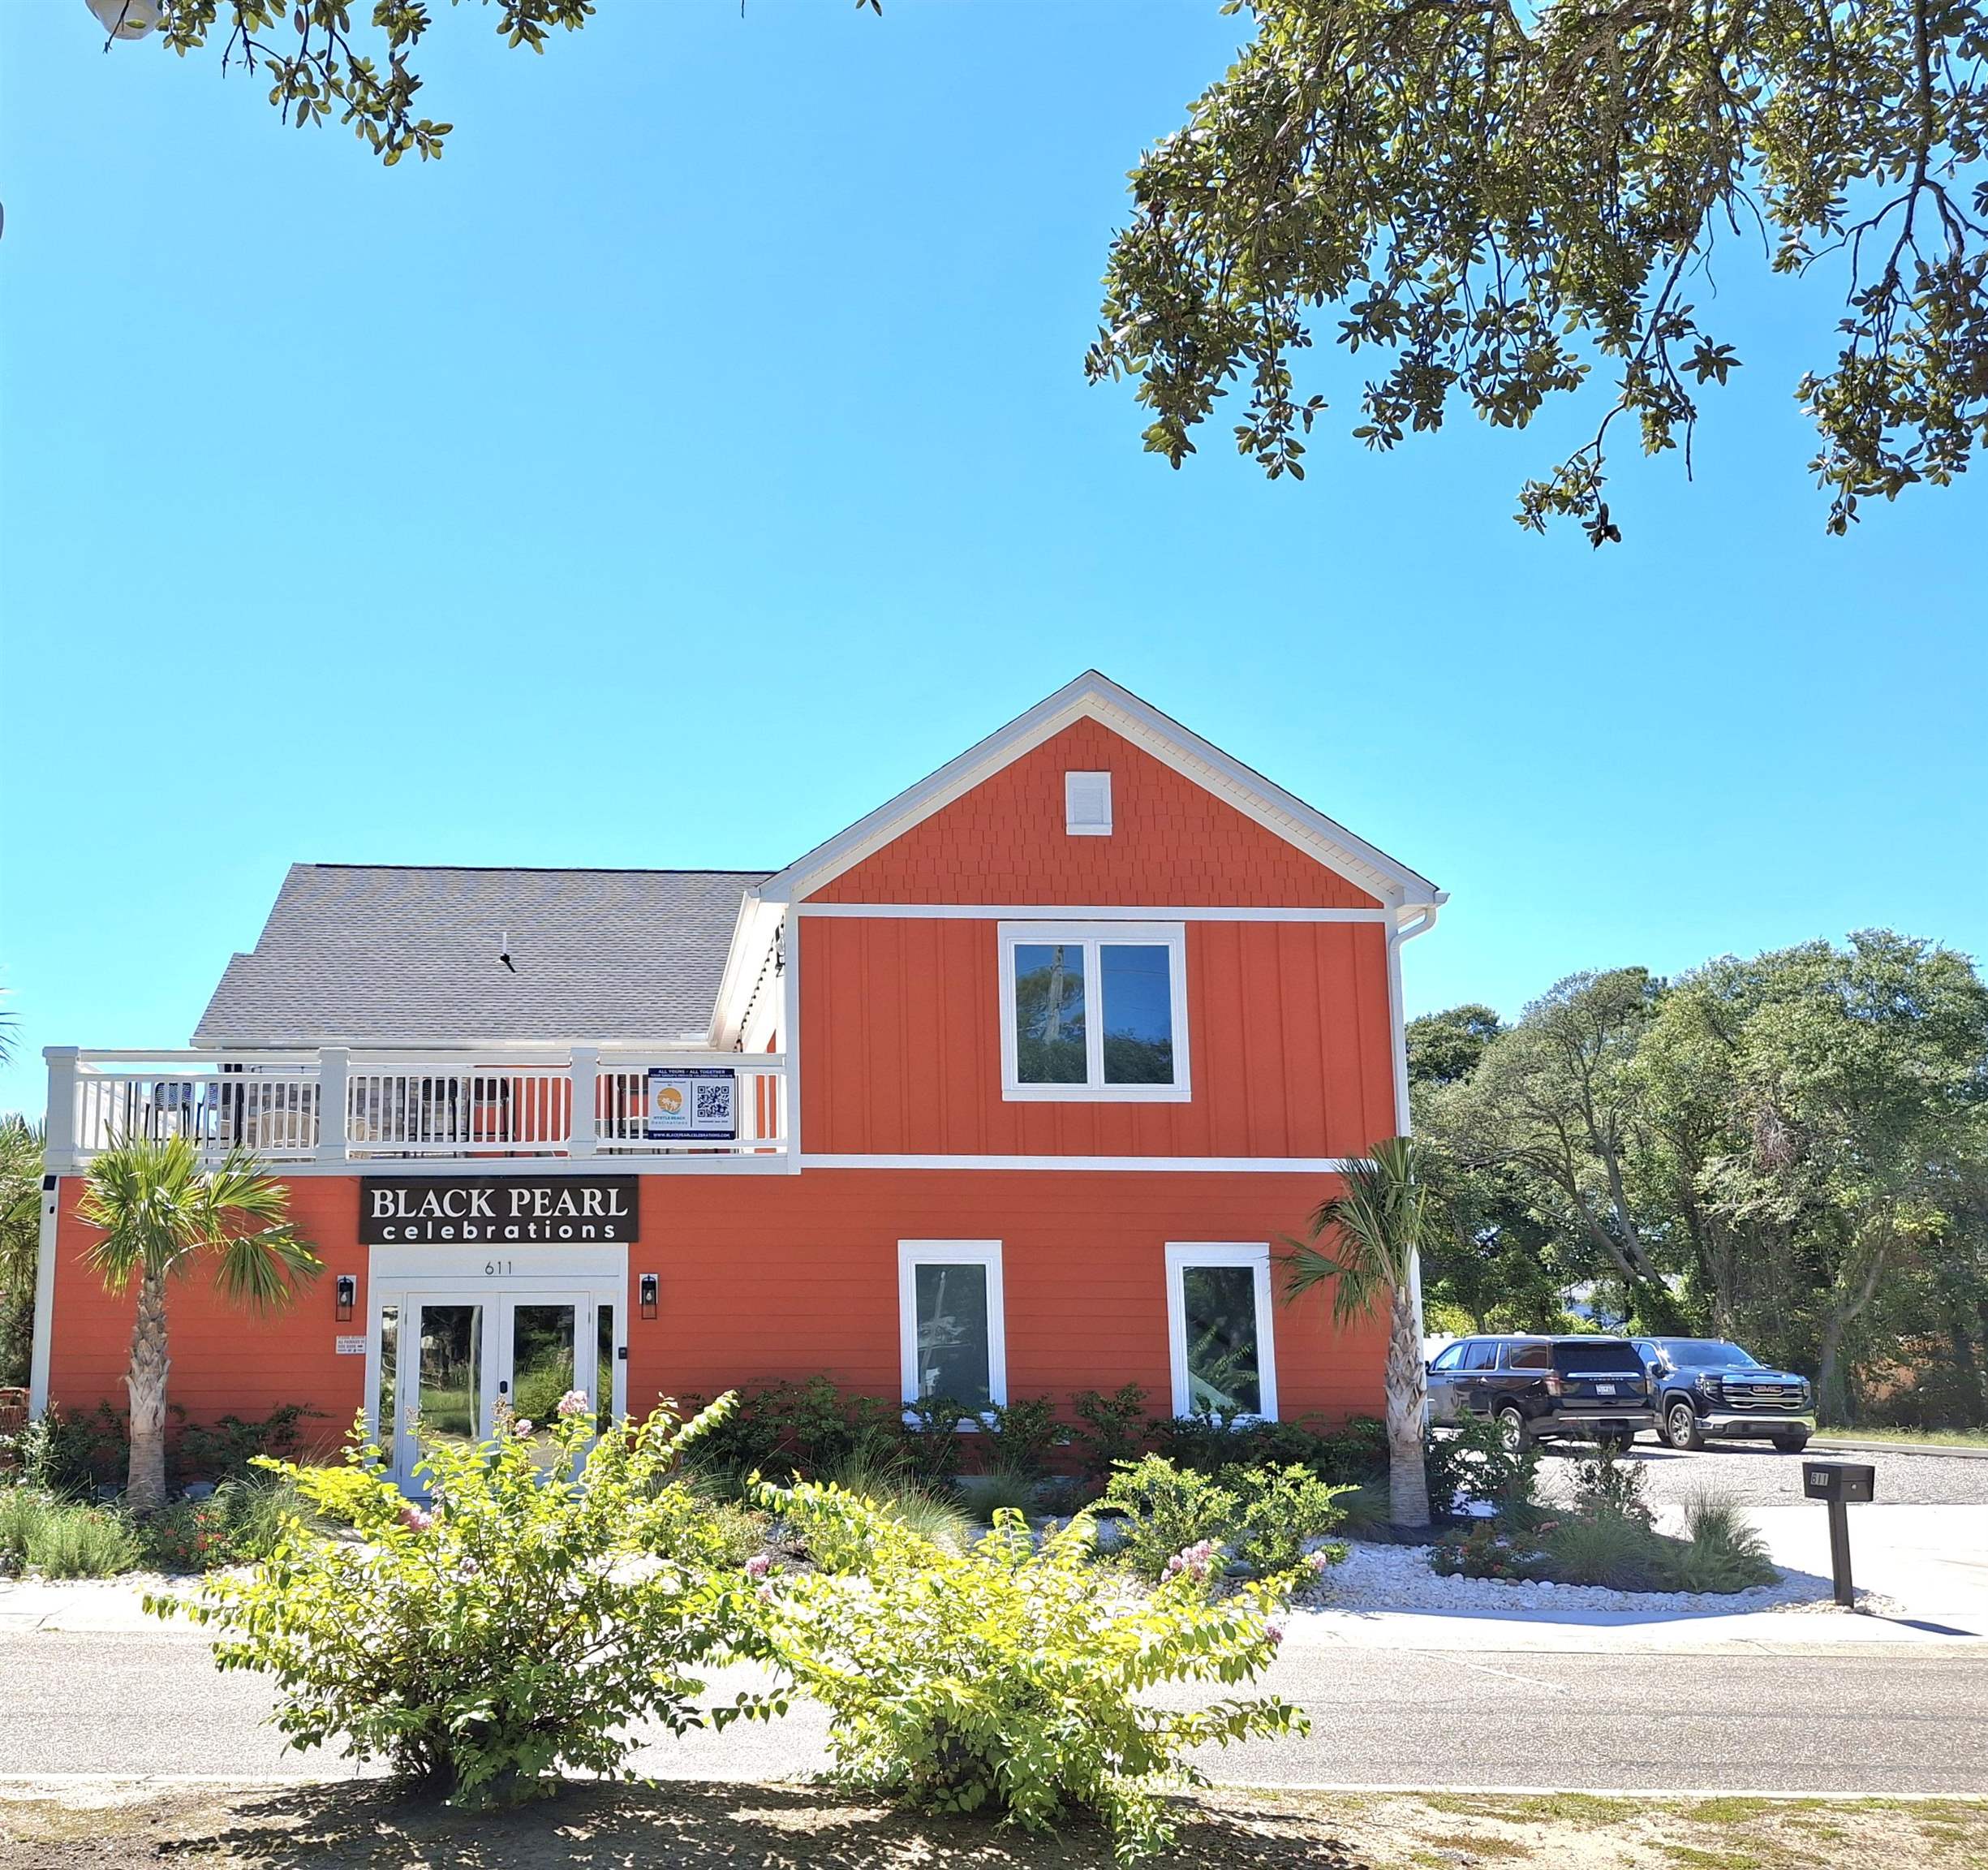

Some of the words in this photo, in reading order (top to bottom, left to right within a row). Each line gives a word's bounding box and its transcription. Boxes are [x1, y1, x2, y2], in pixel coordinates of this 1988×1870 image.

[370, 1189, 497, 1218] BLACK
[508, 1188, 629, 1217] PEARL
[382, 1220, 616, 1240] celebrations
[484, 1260, 513, 1275] 611
[1752, 1385, 1782, 1394] GMC
[1811, 1473, 1827, 1484] 611
